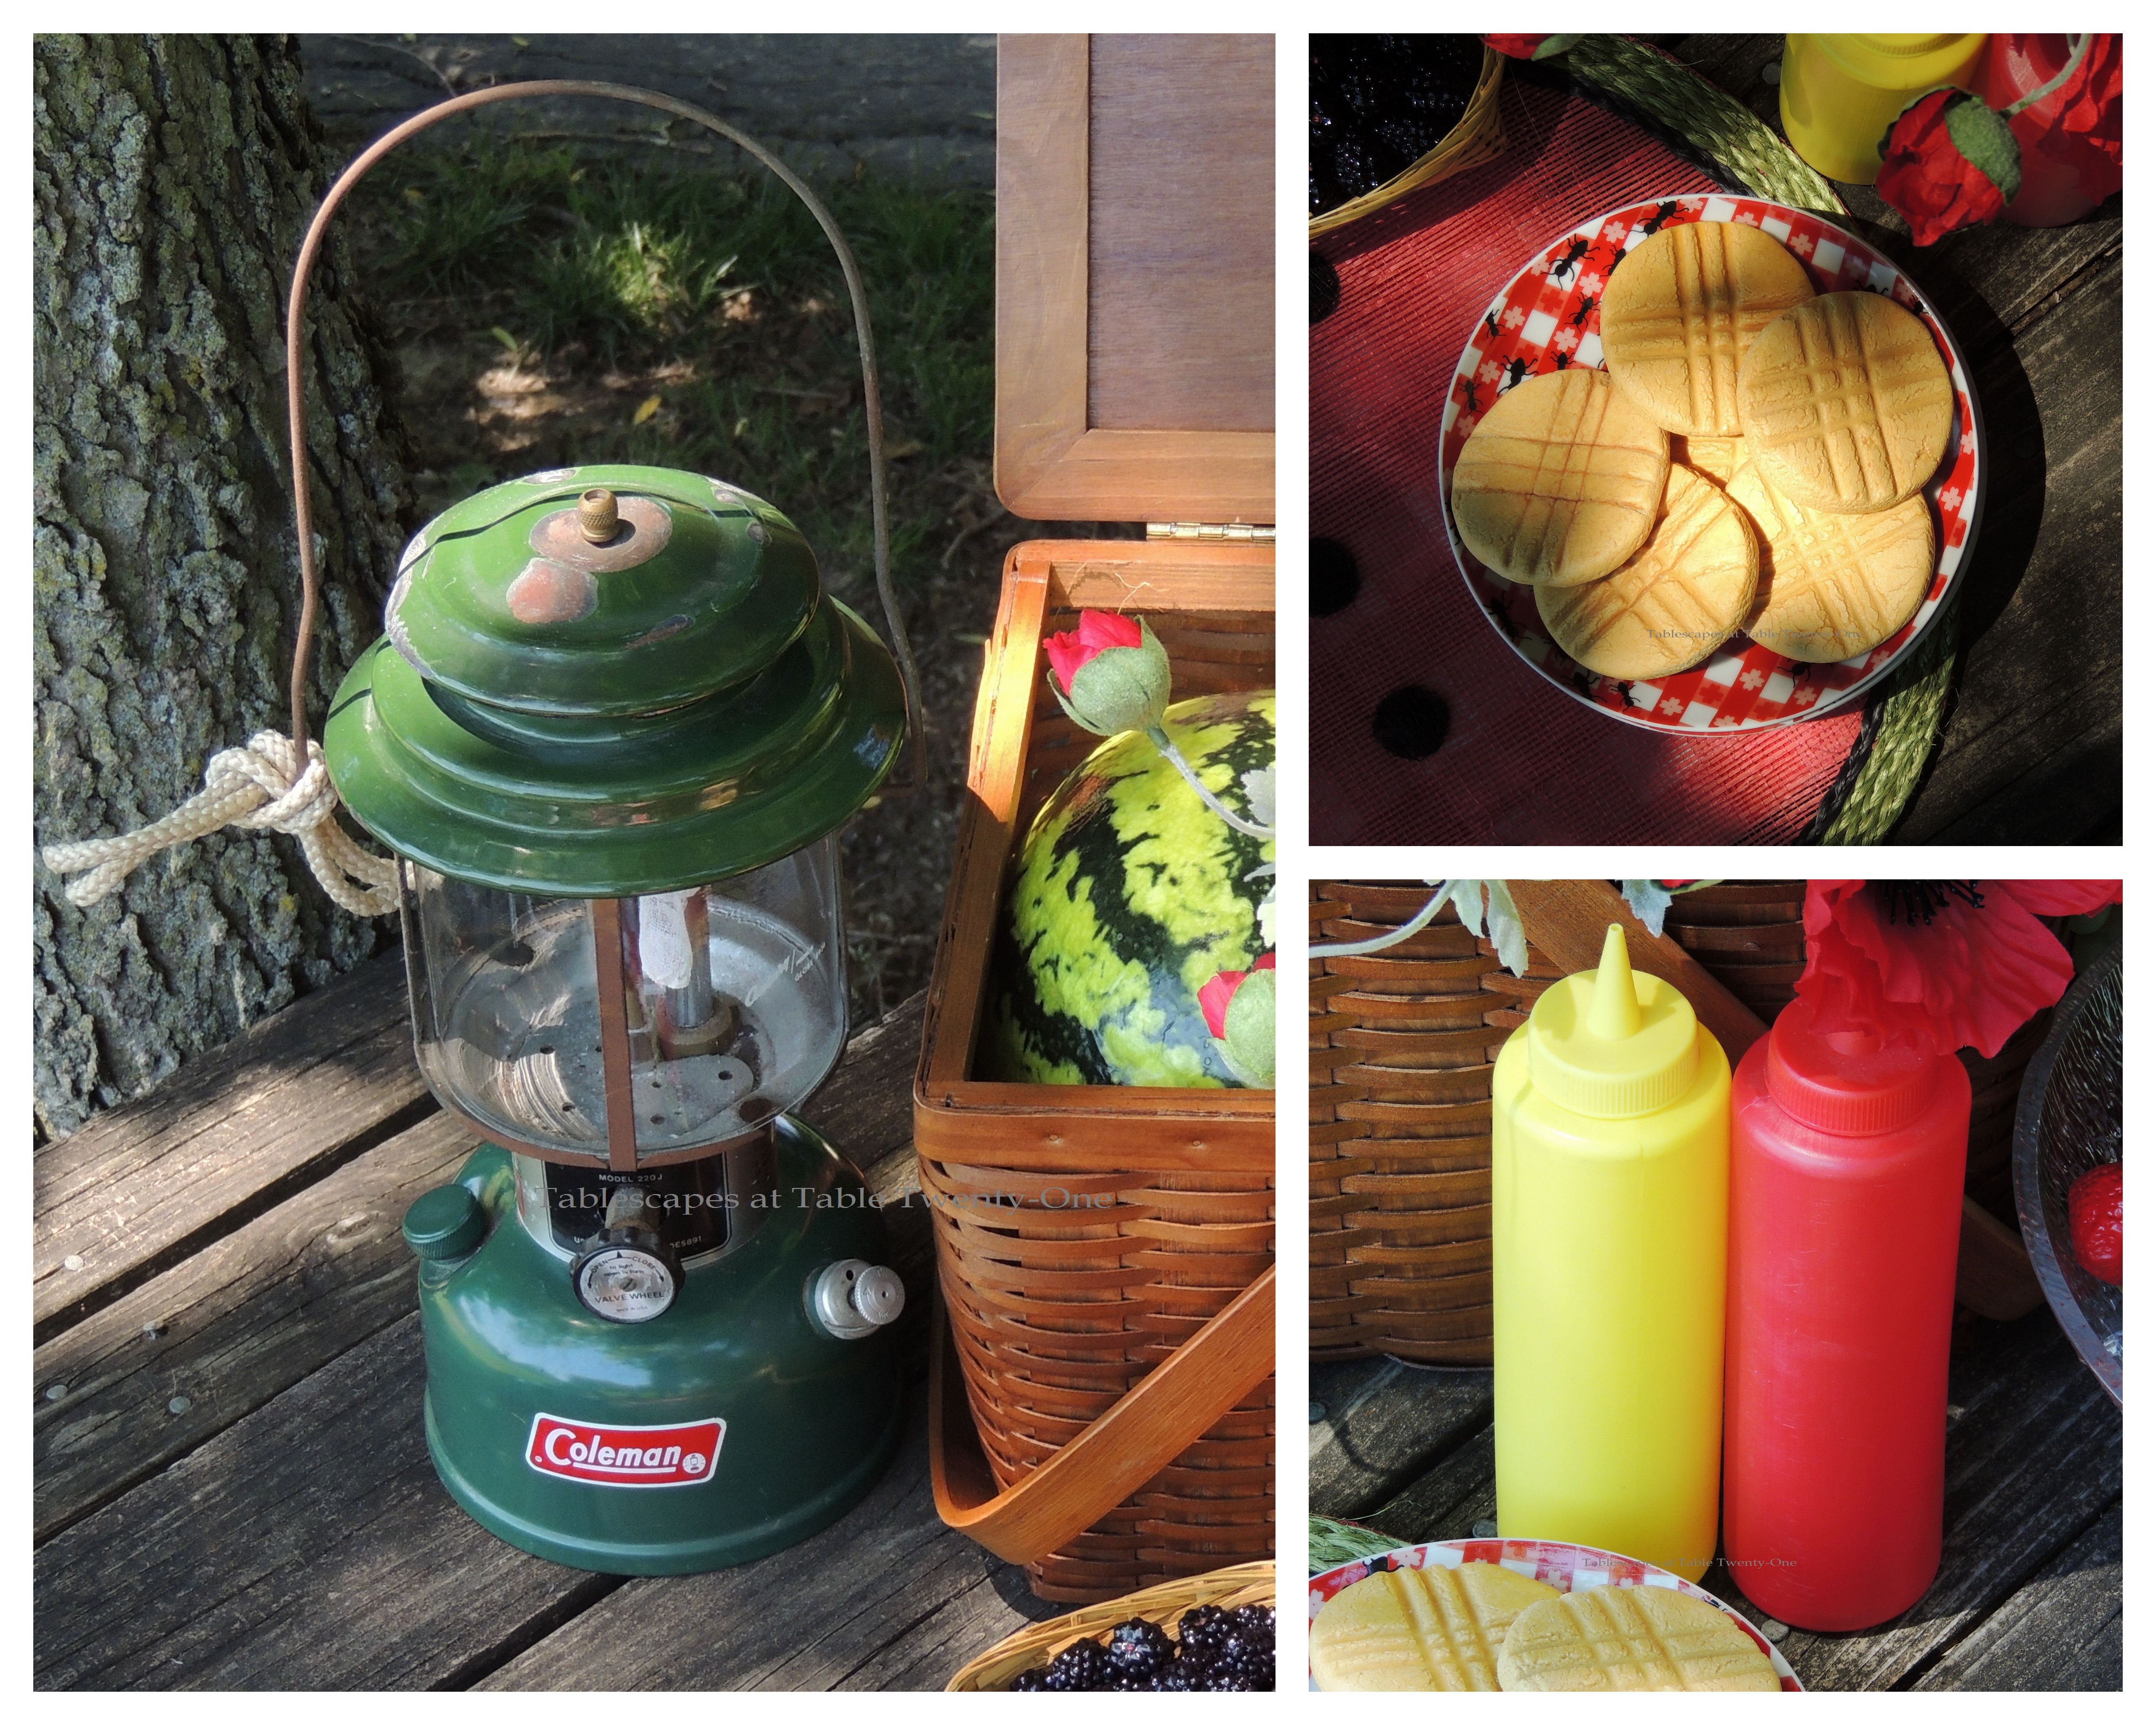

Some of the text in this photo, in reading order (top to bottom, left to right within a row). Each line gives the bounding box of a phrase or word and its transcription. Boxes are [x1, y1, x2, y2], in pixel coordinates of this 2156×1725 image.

[599, 1174, 662, 1183] MODEL 220J
[591, 1259, 608, 1274] OPEN
[632, 1256, 656, 1270] CLOSE
[595, 1292, 664, 1303] VALVE WHEEL
[545, 1428, 682, 1466] Coleman
